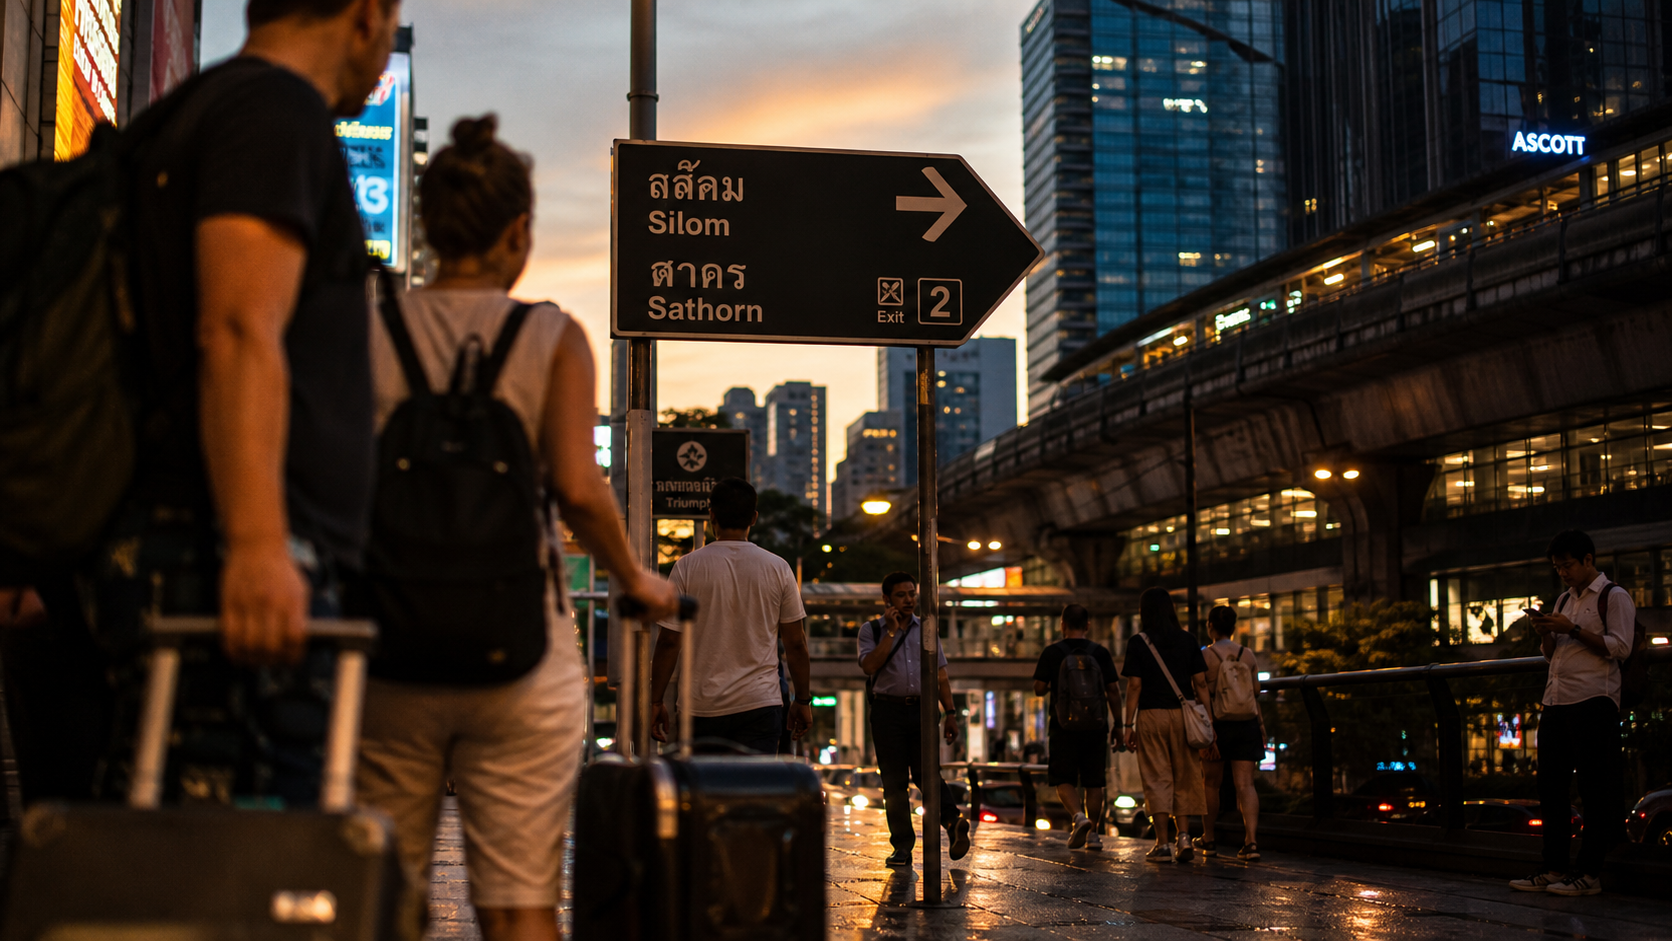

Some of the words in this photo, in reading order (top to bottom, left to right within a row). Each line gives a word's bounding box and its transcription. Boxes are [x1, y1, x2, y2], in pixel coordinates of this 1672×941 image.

[1511, 130, 1586, 155] ASCOTT
[648, 210, 730, 236] Silom
[647, 295, 763, 323] Sathorn
[929, 285, 951, 318] 2
[877, 310, 905, 324] Exit
